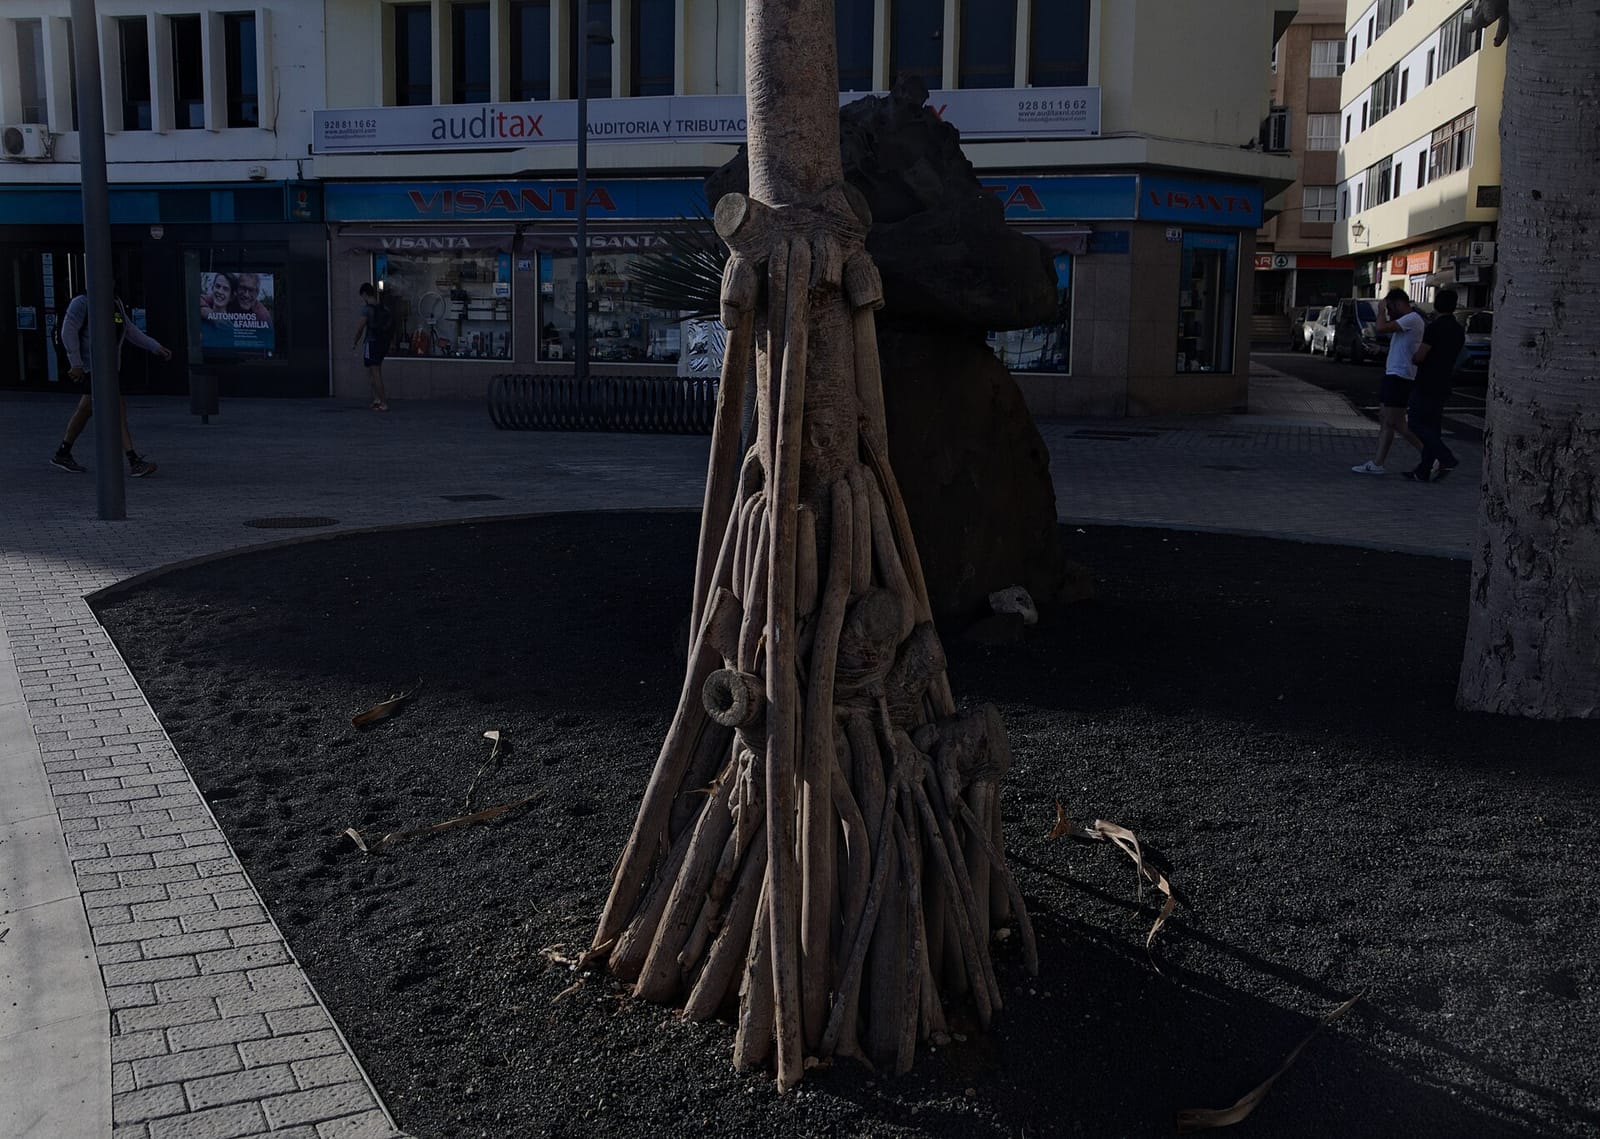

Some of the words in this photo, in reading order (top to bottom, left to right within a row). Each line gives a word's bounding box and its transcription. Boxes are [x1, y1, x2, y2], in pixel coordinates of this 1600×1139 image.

[1018, 101, 1039, 110] 928
[1041, 100, 1053, 110] 81
[1058, 100, 1071, 110] 16
[1073, 99, 1087, 109] 62
[431, 107, 544, 140] auditax
[586, 120, 660, 135] AUDITORIA
[663, 120, 672, 132] Y
[407, 187, 618, 214] VISANTA
[1149, 191, 1253, 216] VISANTA
[381, 236, 471, 249] VISANTA
[568, 235, 669, 248] VISANTA
